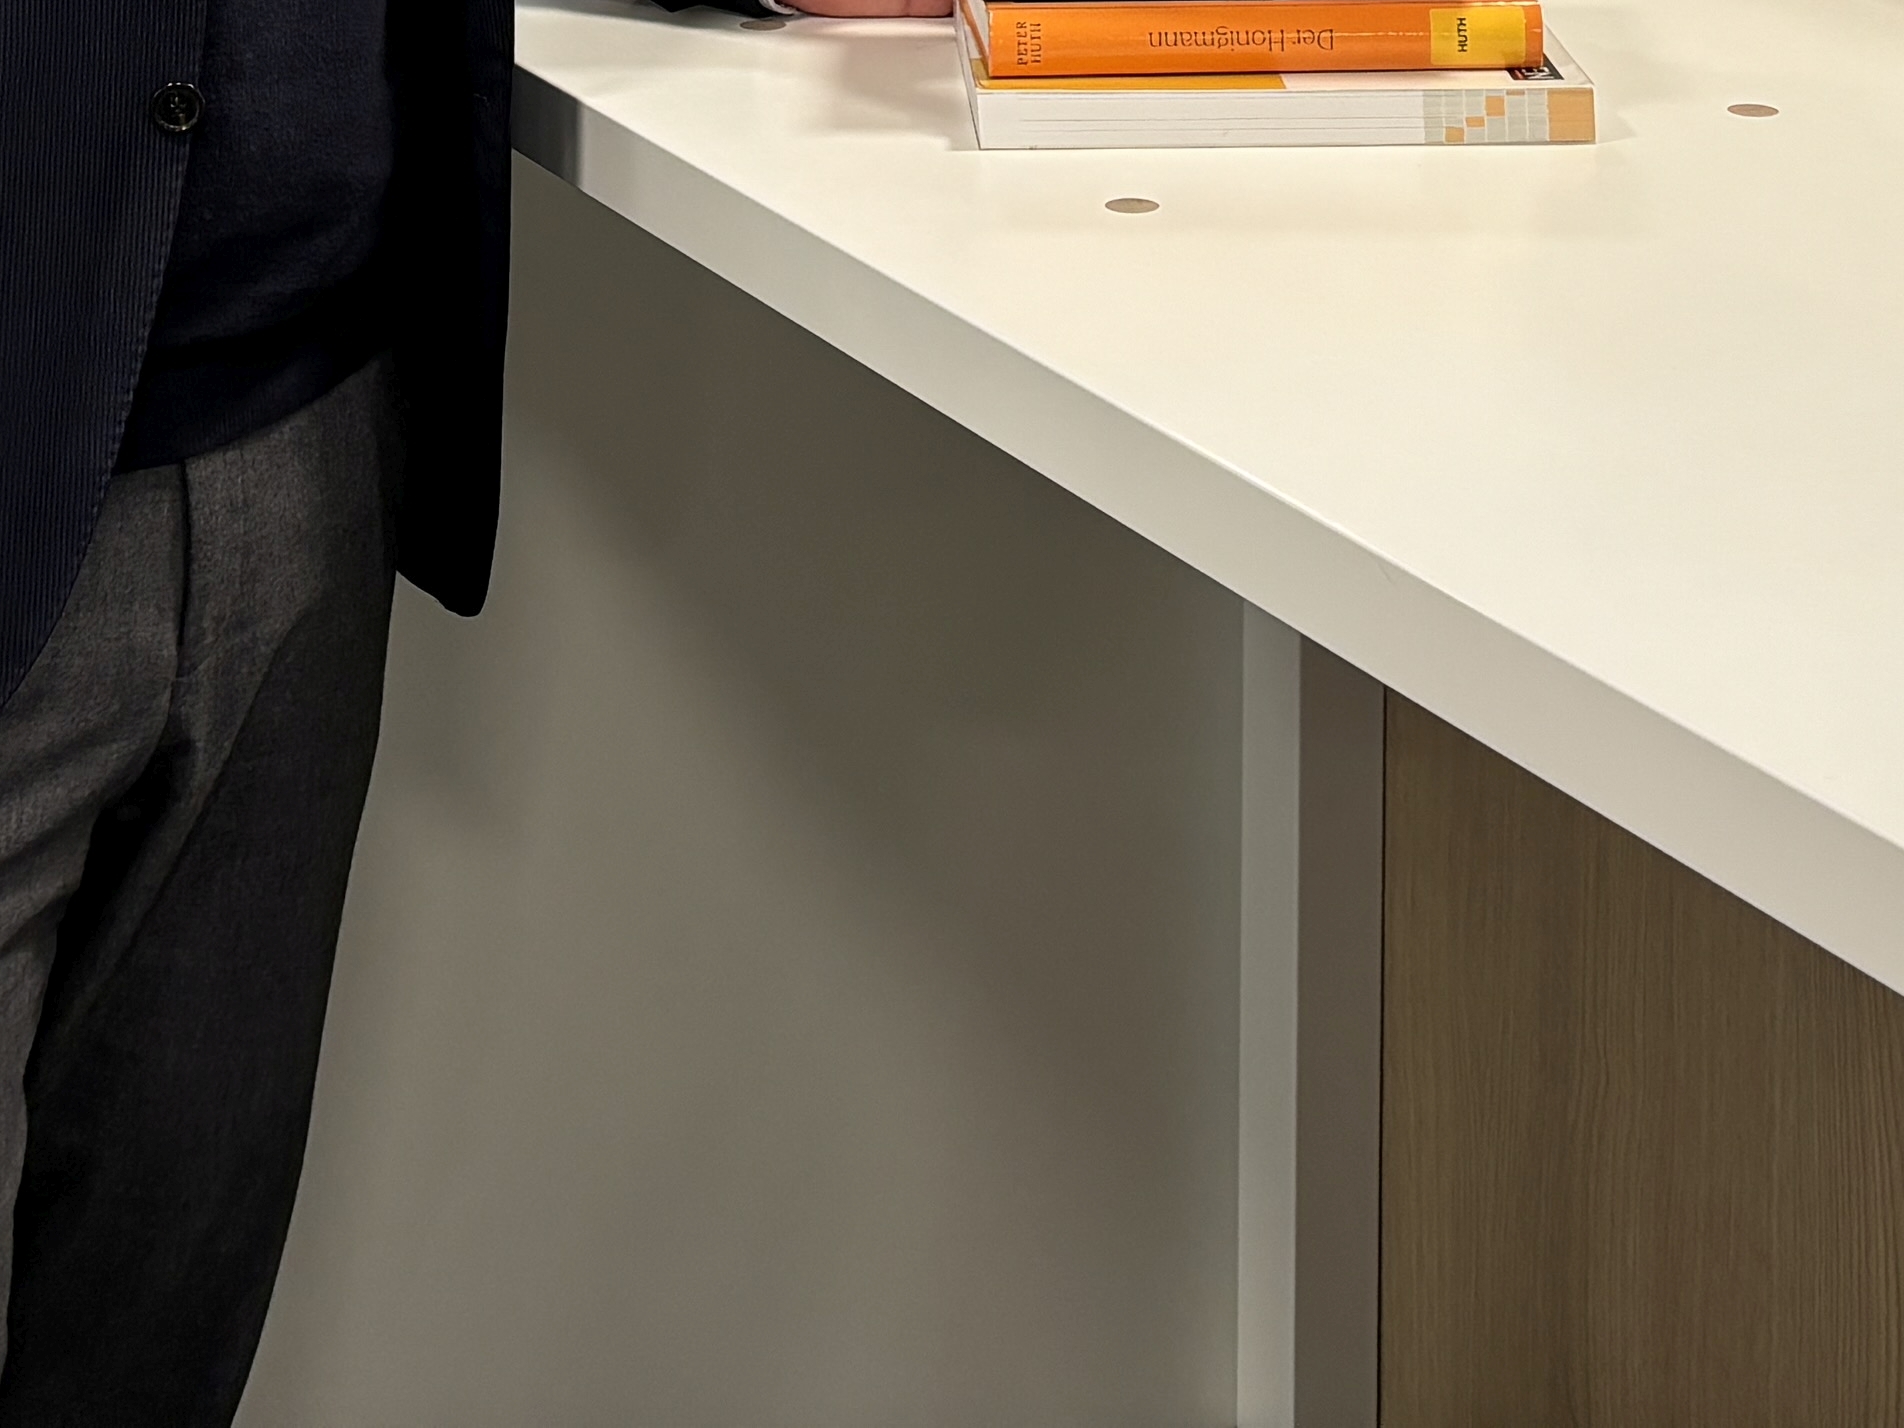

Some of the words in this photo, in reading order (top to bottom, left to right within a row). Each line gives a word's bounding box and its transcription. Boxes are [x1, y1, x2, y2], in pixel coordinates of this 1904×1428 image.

[1016, 20, 1028, 67] PETER
[1030, 22, 1042, 64] HUTH
[1148, 25, 1285, 53] Honigmann
[1296, 28, 1334, 51] Der
[1457, 17, 1468, 52] HUTH
